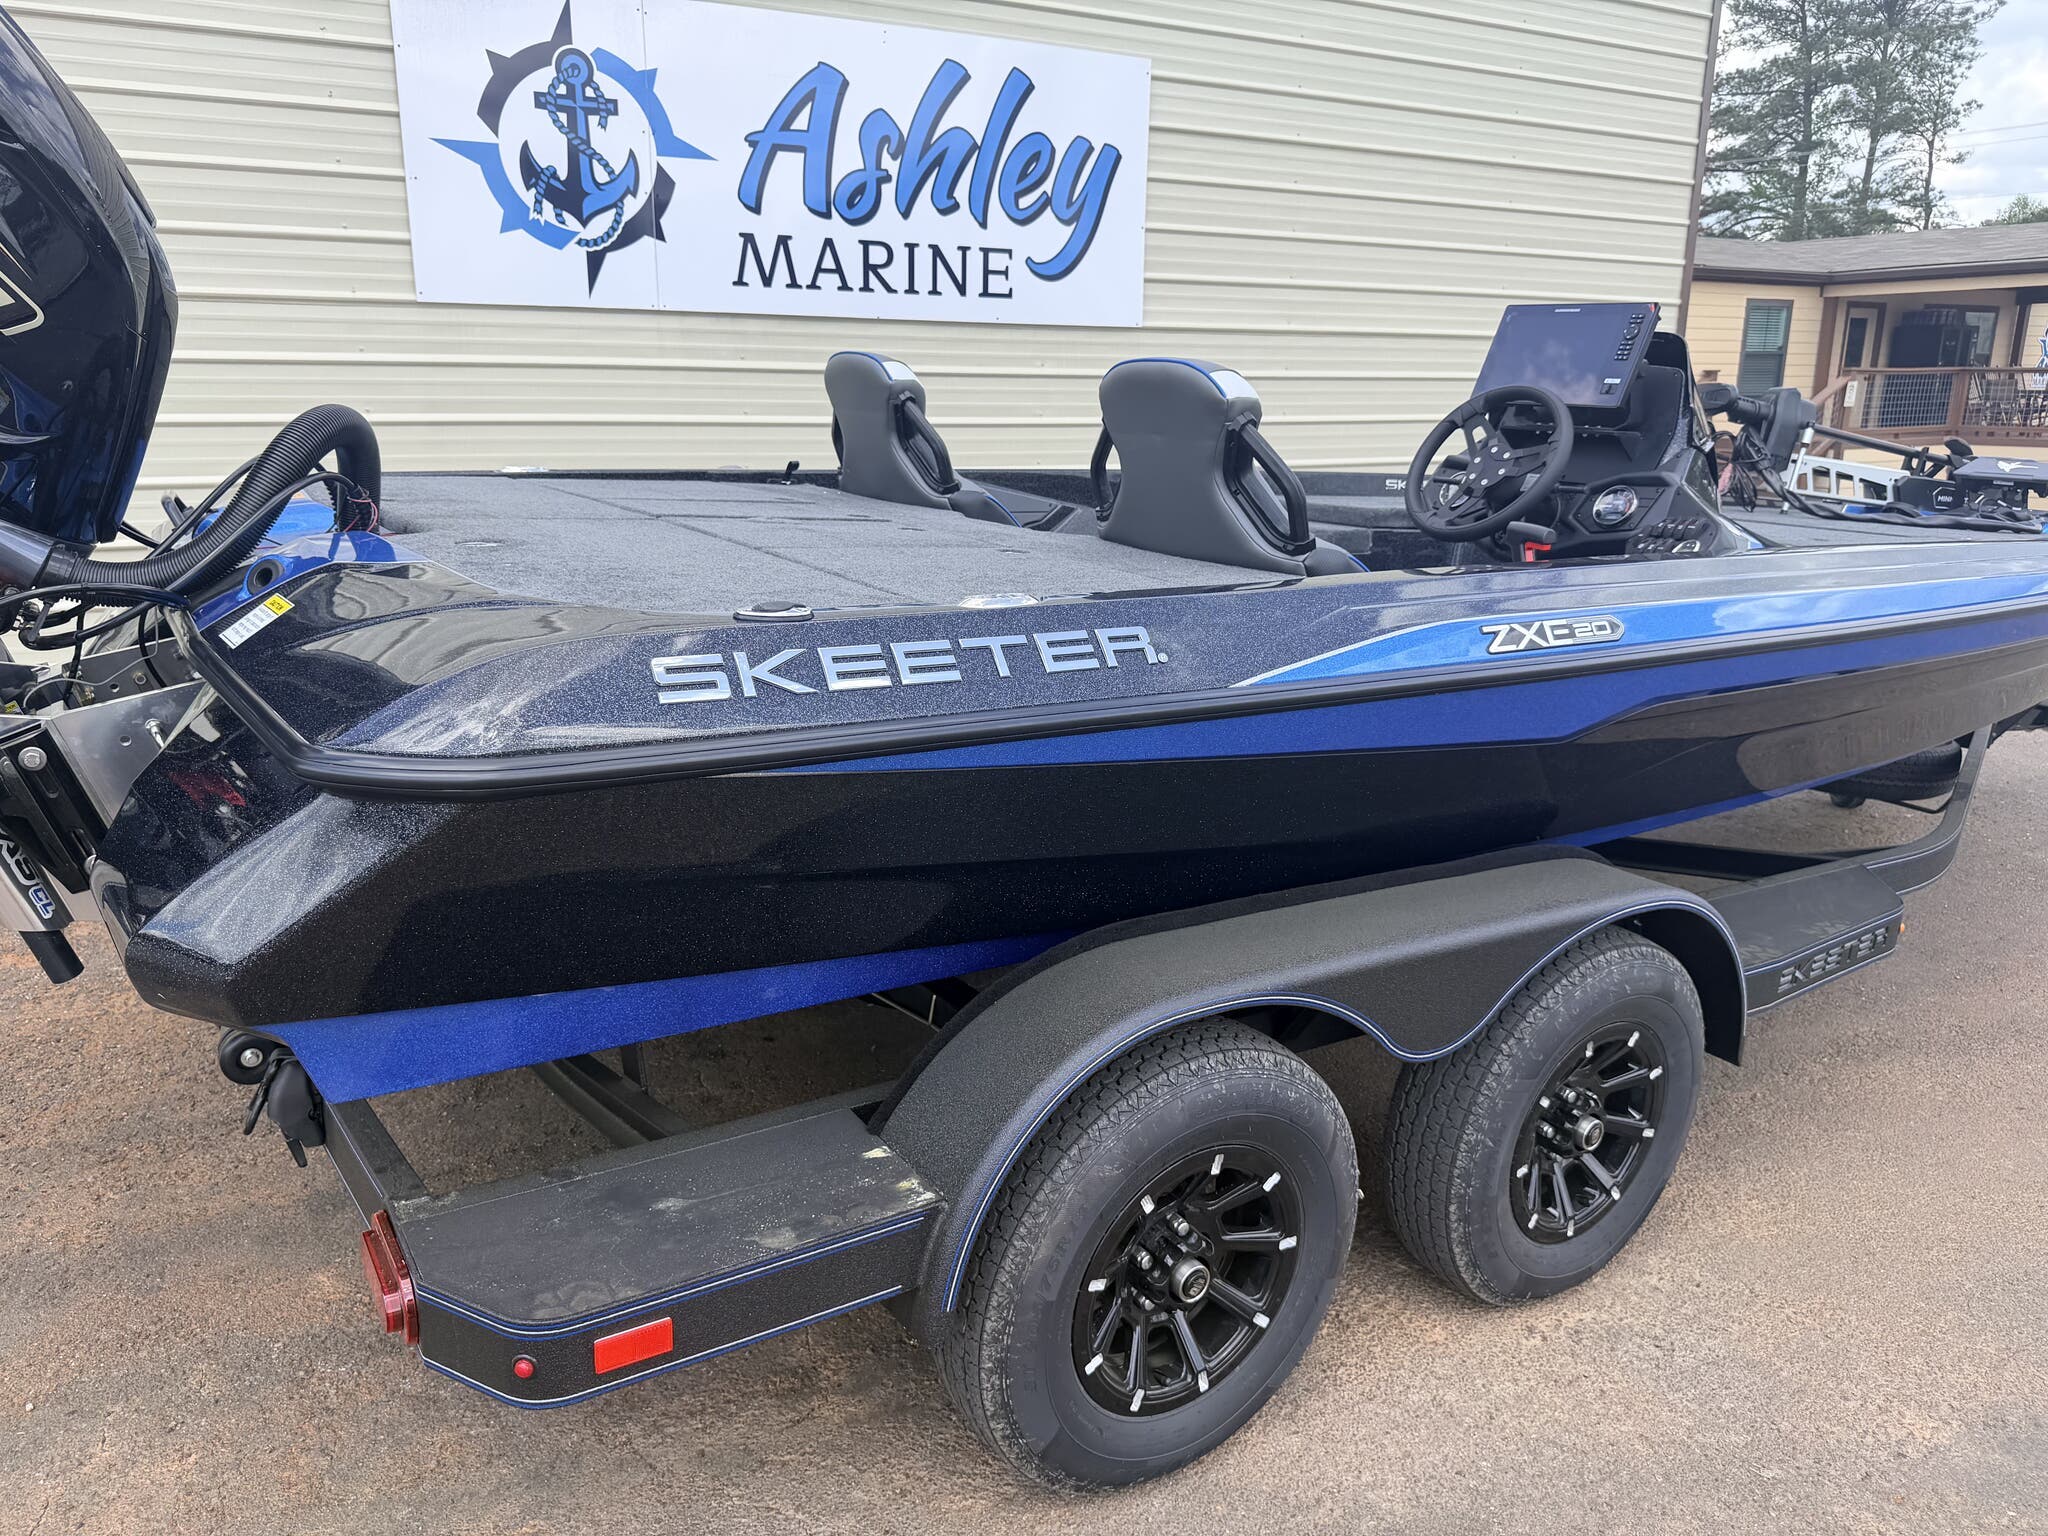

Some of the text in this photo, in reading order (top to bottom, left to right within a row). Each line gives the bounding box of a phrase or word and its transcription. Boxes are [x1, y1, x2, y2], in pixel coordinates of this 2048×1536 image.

[738, 58, 1122, 282] Ashley
[732, 232, 1014, 298] MARINE
[1385, 479, 1407, 491] SK
[650, 625, 1159, 704] SKEETER
[1777, 926, 1889, 993] SKEETER
